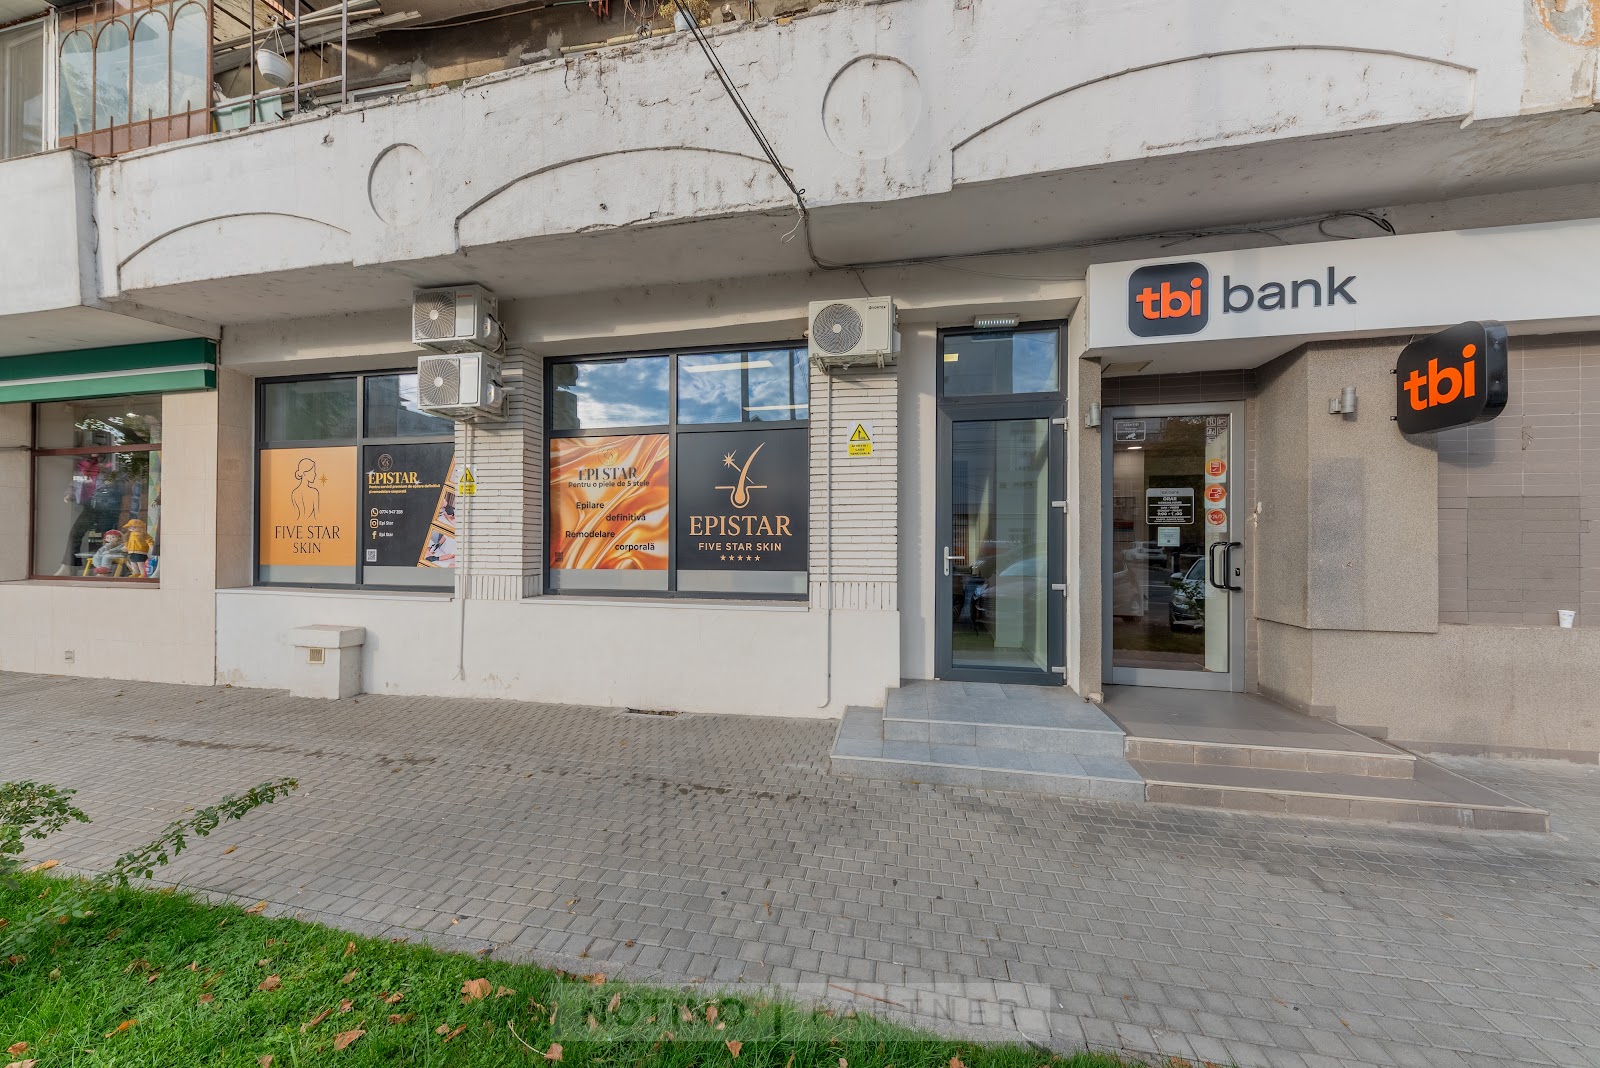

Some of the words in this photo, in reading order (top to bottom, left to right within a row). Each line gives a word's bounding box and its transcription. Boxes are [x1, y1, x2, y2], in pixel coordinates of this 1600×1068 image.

[1136, 277, 1203, 320] tbi
[1222, 266, 1358, 314] bank
[1403, 343, 1477, 411] tbi
[368, 471, 418, 485] EPISTAR
[598, 481, 615, 489] piele
[575, 501, 605, 510] Epilare
[605, 513, 646, 521] definitivă
[689, 515, 793, 536] EPISTAR
[275, 525, 303, 539] FIVE
[307, 525, 340, 539] STAR
[565, 530, 616, 538] Remodelare
[293, 541, 321, 554] SKIN
[614, 542, 655, 551] corporală
[698, 542, 722, 551] FIVE
[725, 542, 753, 551] STAR
[756, 542, 782, 551] SKIN
